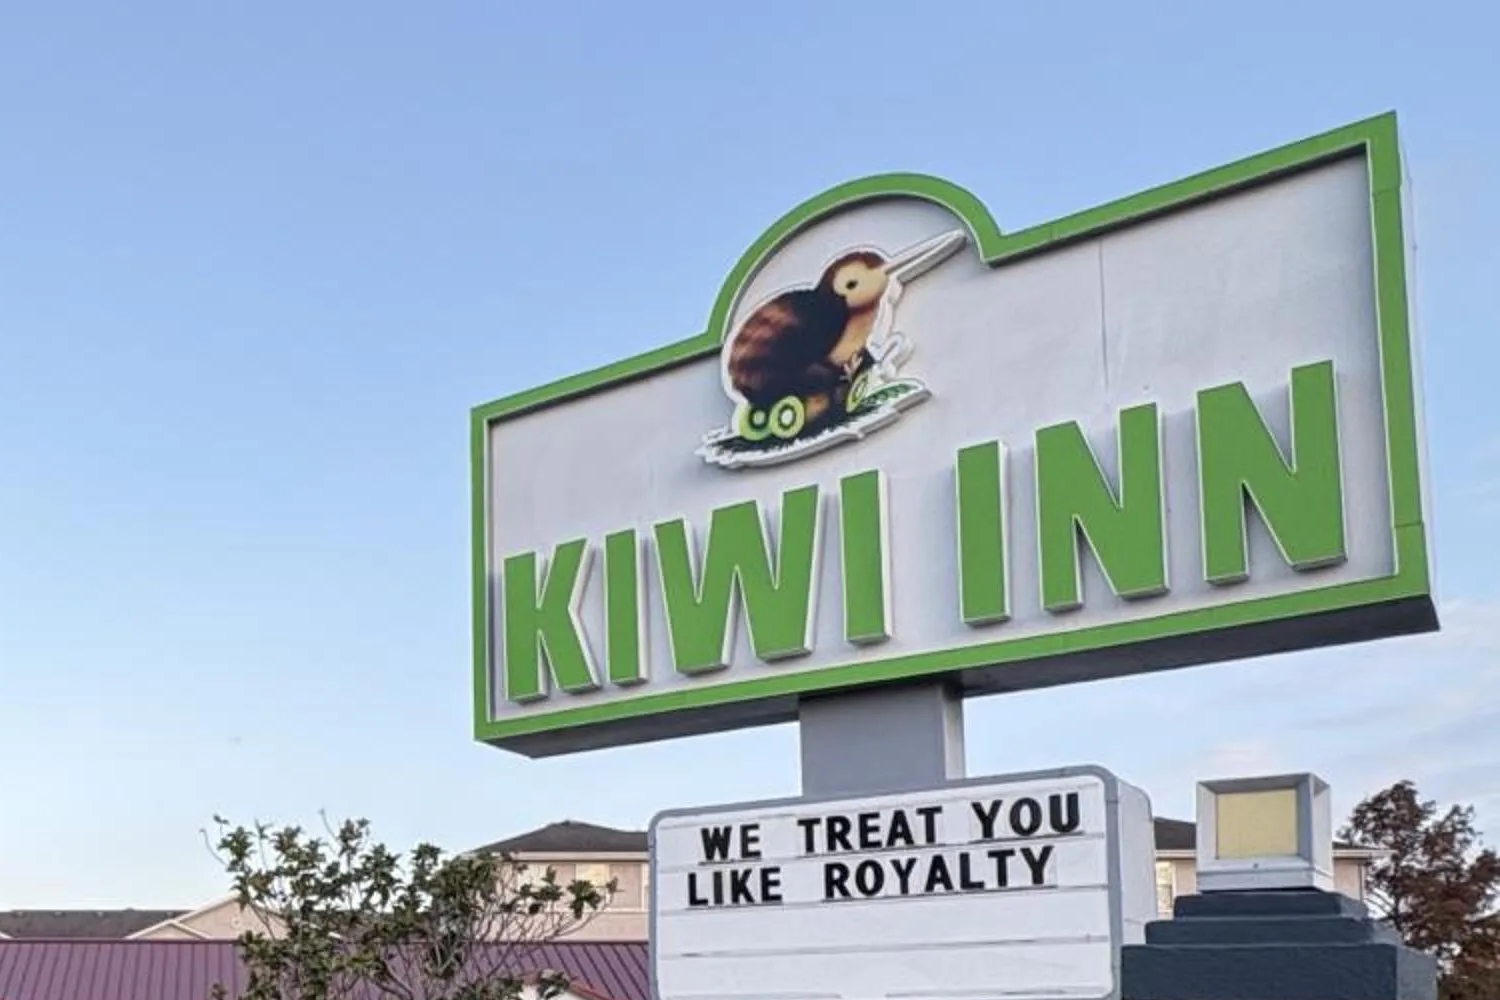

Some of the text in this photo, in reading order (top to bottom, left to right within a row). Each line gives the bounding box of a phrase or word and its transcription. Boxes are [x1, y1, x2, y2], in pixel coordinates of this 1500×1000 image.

[504, 361, 1345, 702] KIWI INN
[701, 792, 1080, 861] WE TREAT YOU
[687, 845, 1053, 907] LIKE ROYALTY
